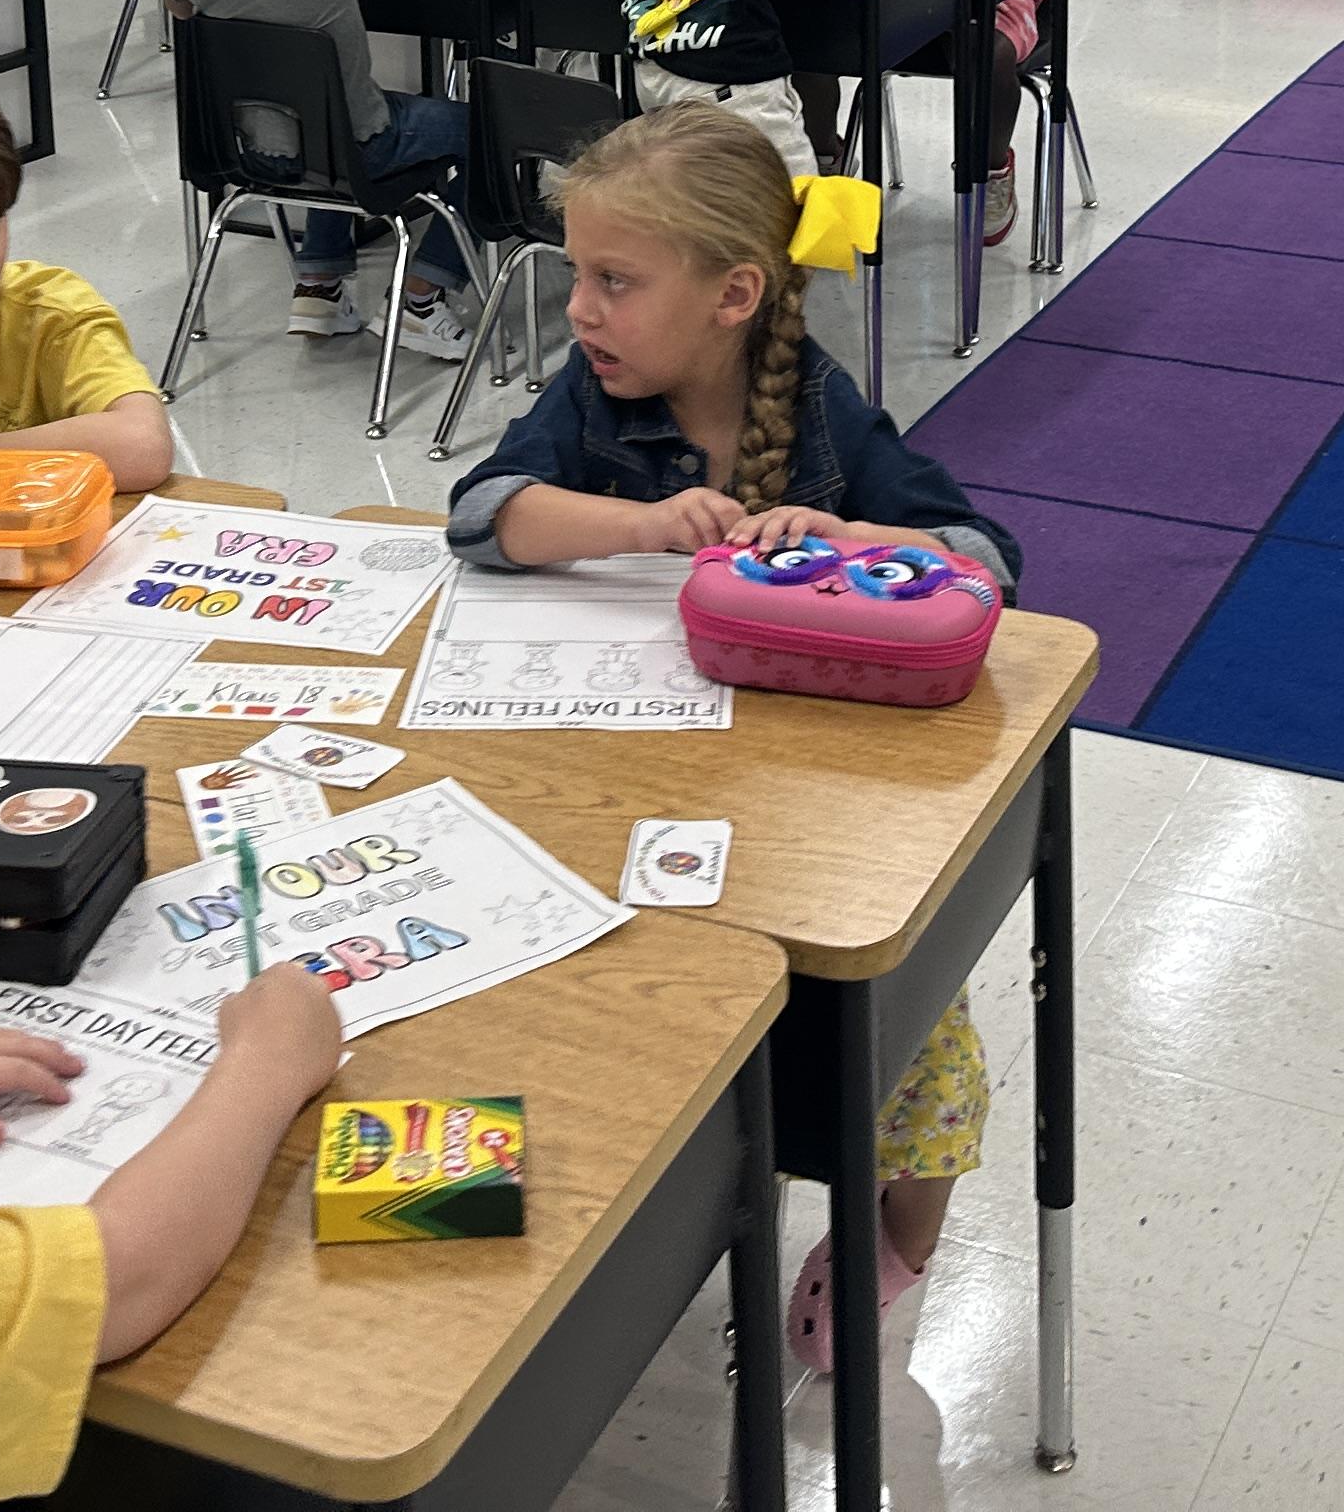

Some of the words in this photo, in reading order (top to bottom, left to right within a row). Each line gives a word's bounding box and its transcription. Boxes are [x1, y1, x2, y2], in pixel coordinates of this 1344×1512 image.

[214, 528, 342, 569] ERA
[145, 559, 278, 588] GRADE
[277, 574, 355, 595] 1ST
[124, 578, 242, 619] OUR
[249, 593, 336, 627] IN
[205, 681, 282, 705] Klaus
[292, 684, 326, 705] 18
[419, 700, 561, 717] FEELINGS
[567, 701, 619, 717] DAY
[626, 701, 720, 717] FIRST
[156, 884, 262, 943] IN
[261, 833, 421, 900] OUR
[287, 866, 457, 934] GRADE
[80, 1012, 156, 1046] DAY
[142, 1029, 219, 1067] FEEL
